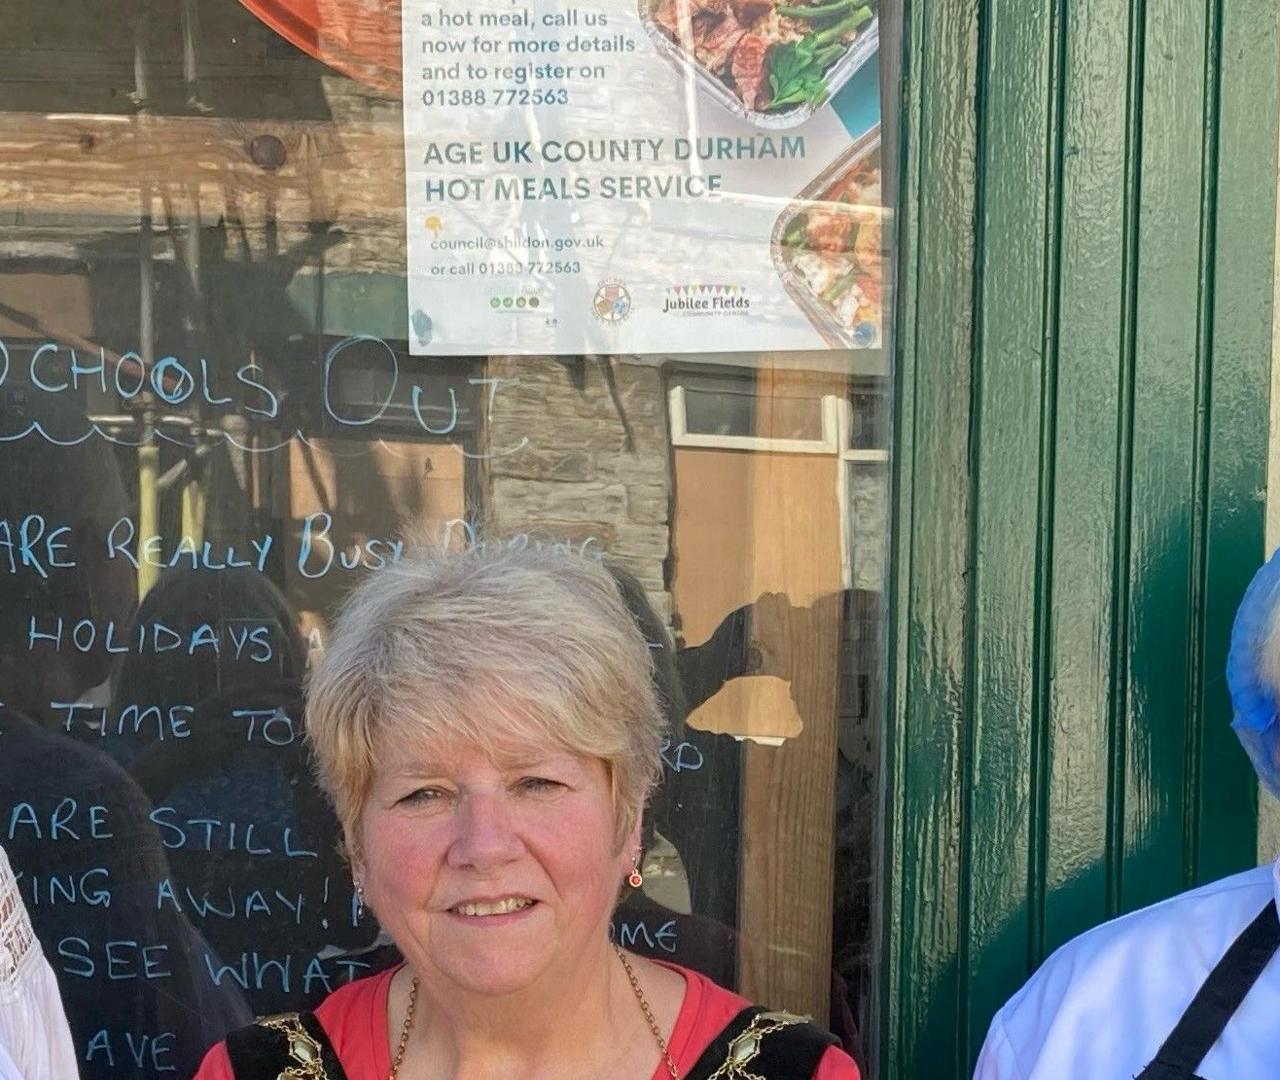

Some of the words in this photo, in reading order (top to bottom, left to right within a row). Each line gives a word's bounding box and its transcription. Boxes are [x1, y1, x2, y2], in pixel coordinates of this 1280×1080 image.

[421, 13, 432, 27] a
[439, 9, 473, 27] hot
[480, 9, 535, 30] meal,
[542, 9, 578, 27] call
[585, 13, 608, 27] us
[422, 38, 466, 53] now
[473, 35, 502, 53] for
[508, 37, 560, 52] more
[566, 34, 636, 53] details
[422, 62, 460, 80] and
[467, 64, 488, 80] to
[494, 62, 575, 84] register
[579, 65, 606, 80] on
[422, 89, 486, 106] 01388
[493, 88, 569, 105] 772563
[423, 141, 482, 165] AGE
[493, 140, 533, 164] UK
[540, 138, 665, 163] COUNTY
[674, 135, 807, 161] DURHAM
[425, 178, 486, 201] HOT
[494, 177, 590, 200] MEALS
[599, 174, 722, 199] SERVICE
[430, 234, 605, 251] council@shildon.gov.uk
[431, 265, 445, 276] or
[449, 263, 475, 276] call
[528, 261, 581, 274] 772563
[662, 297, 709, 313] Jubilee
[712, 296, 750, 310] Fields
[324, 334, 520, 434] OUT
[108, 516, 272, 572] REALLY
[28, 615, 272, 663] HOLIDAYS
[50, 701, 195, 742] TIME
[232, 707, 295, 746] TO
[8, 798, 113, 841] ARE
[149, 806, 318, 858] STILL
[16, 868, 111, 909] ING
[158, 876, 329, 930] AWAY!
[57, 936, 171, 980] SEE
[205, 952, 371, 994] WHAT
